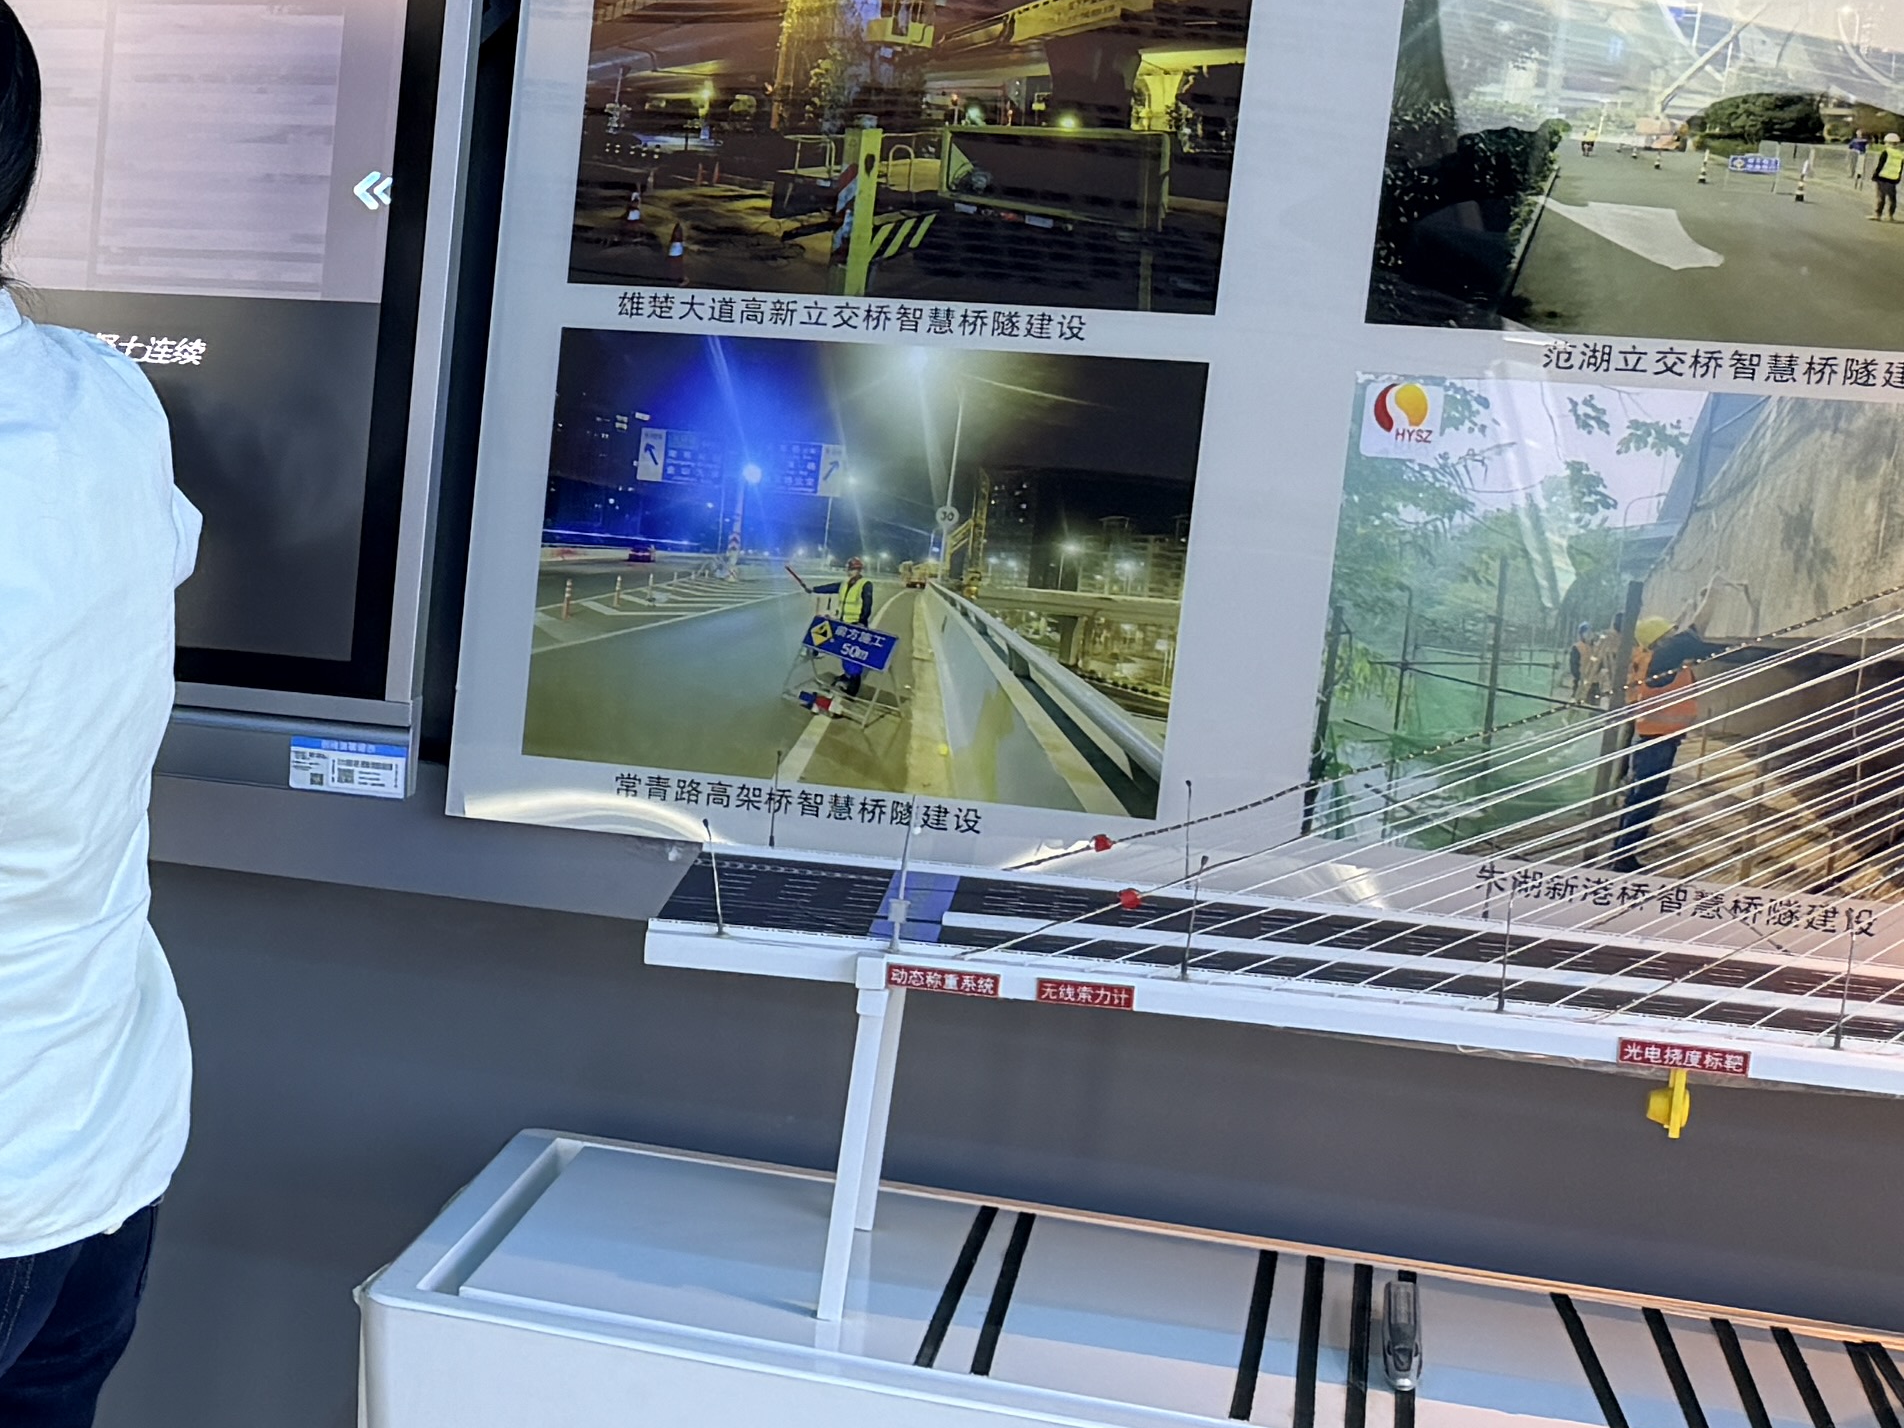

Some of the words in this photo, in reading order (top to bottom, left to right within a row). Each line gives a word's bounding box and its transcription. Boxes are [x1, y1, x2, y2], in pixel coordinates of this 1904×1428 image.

[617, 291, 1087, 341] 雄楚大道高新立交桥智慧桥隧建设
[1395, 428, 1433, 443] HYSZ
[840, 643, 869, 661] 50m
[615, 772, 982, 835] 常青路高架桥智慧桥隧建设
[891, 968, 994, 995] 动态称重系统
[1041, 982, 1129, 1007] 无线索力计
[1623, 1043, 1743, 1072] 光电挠度标靶
